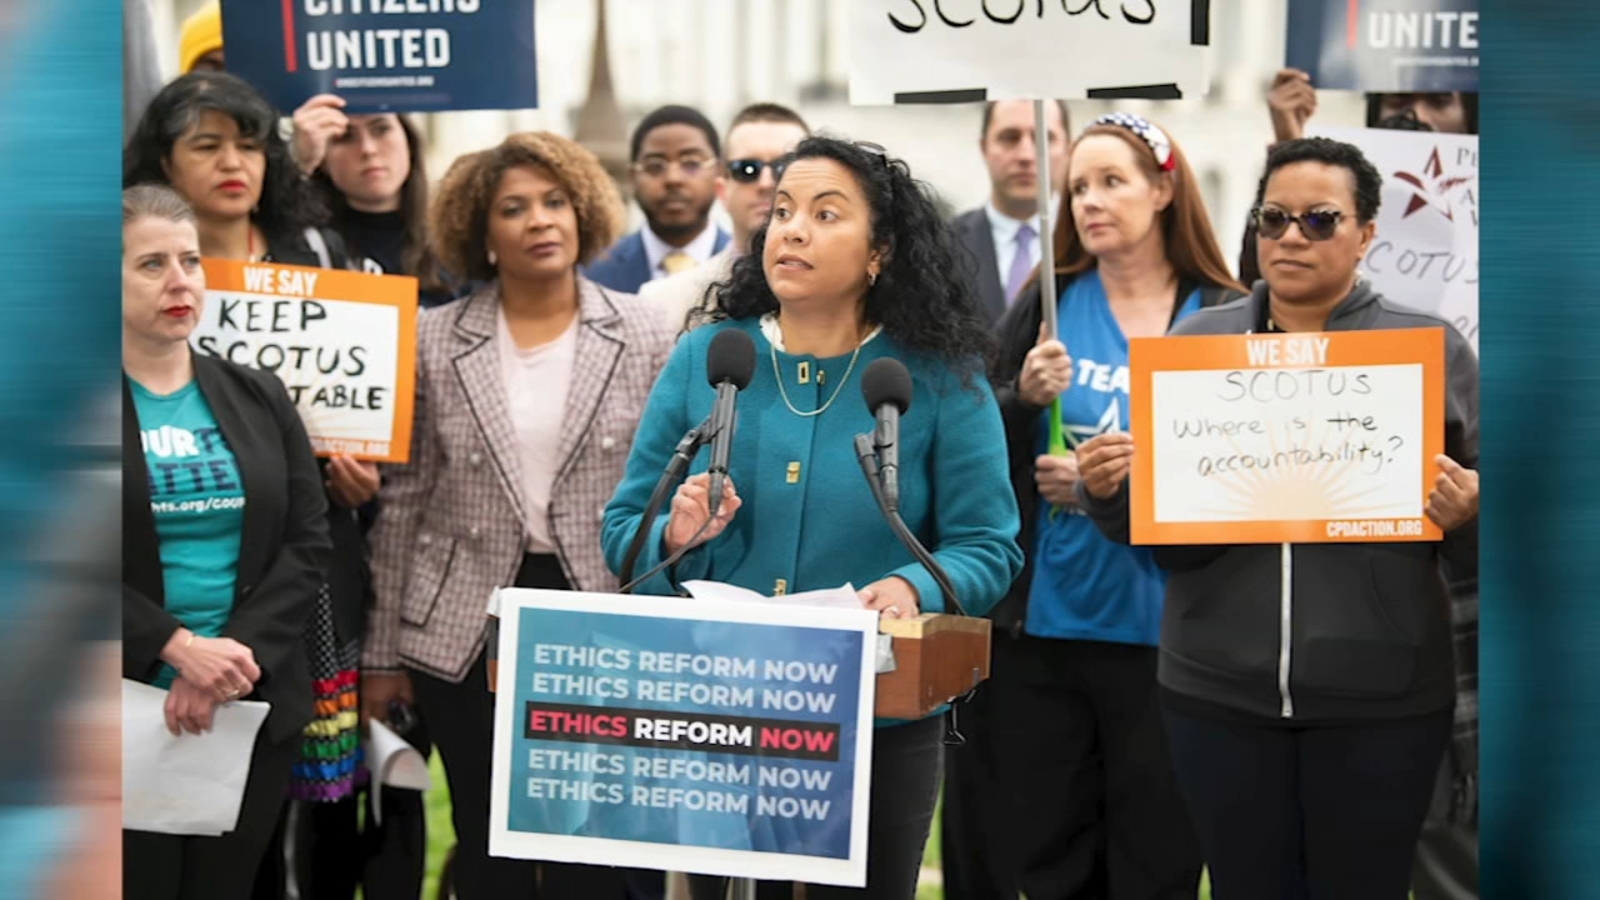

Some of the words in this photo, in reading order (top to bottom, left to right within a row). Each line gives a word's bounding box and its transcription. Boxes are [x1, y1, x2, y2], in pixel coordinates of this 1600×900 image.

[307, 28, 450, 70] UNITED
[1369, 12, 1479, 48] UNITE
[243, 267, 275, 292] WE
[277, 270, 318, 296] SAY
[1366, 241, 1478, 284] COTU
[219, 299, 327, 332] KEEP
[198, 336, 367, 376] SCOTUS
[1246, 339, 1281, 366] WE
[1286, 337, 1330, 365] SAY
[1077, 358, 1130, 394] TEA
[1217, 370, 1372, 402] SCOTUS
[289, 384, 388, 410] TABLE
[1173, 417, 1265, 438] Where
[1284, 415, 1307, 431] is
[1326, 410, 1378, 433] the
[1198, 435, 1404, 476] accountability?
[1326, 519, 1424, 538] CPDACTION.ORG
[534, 643, 631, 671] ETHICS
[638, 650, 756, 679] REFORM
[763, 660, 838, 685] NOW
[532, 673, 629, 699] ETHICS
[636, 680, 754, 708] REFORM
[762, 689, 837, 714] NOW
[529, 709, 628, 737] ETHICS
[634, 717, 752, 747] REFORM
[759, 727, 835, 752] NOW
[528, 748, 625, 775] ETHICS
[632, 756, 750, 785] REFORM
[757, 767, 832, 791] NOW
[526, 778, 624, 804] ETHICS
[631, 785, 748, 815] REFORM
[756, 796, 830, 820] NOW
